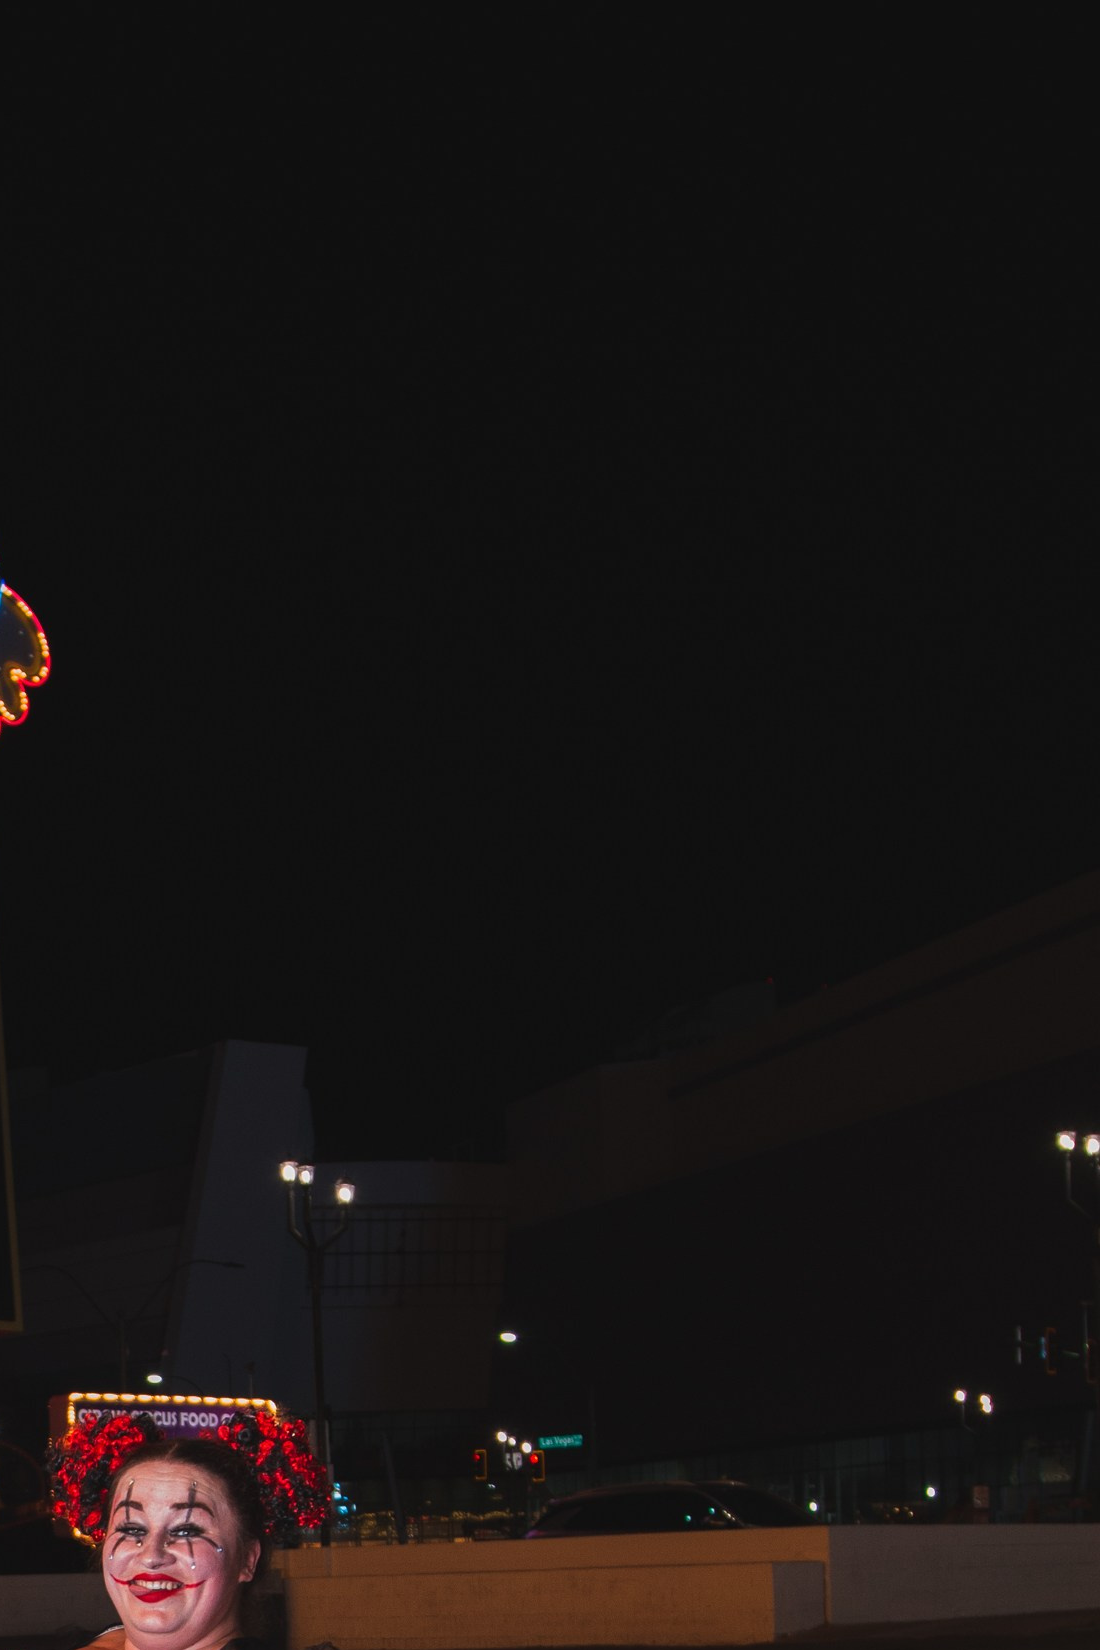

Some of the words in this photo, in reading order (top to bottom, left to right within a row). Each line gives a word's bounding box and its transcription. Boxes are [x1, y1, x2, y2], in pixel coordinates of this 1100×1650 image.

[131, 1410, 178, 1426] CUS
[180, 1412, 218, 1427] FOOD
[541, 1437, 554, 1446] Las
[554, 1435, 575, 1447] Vegas
